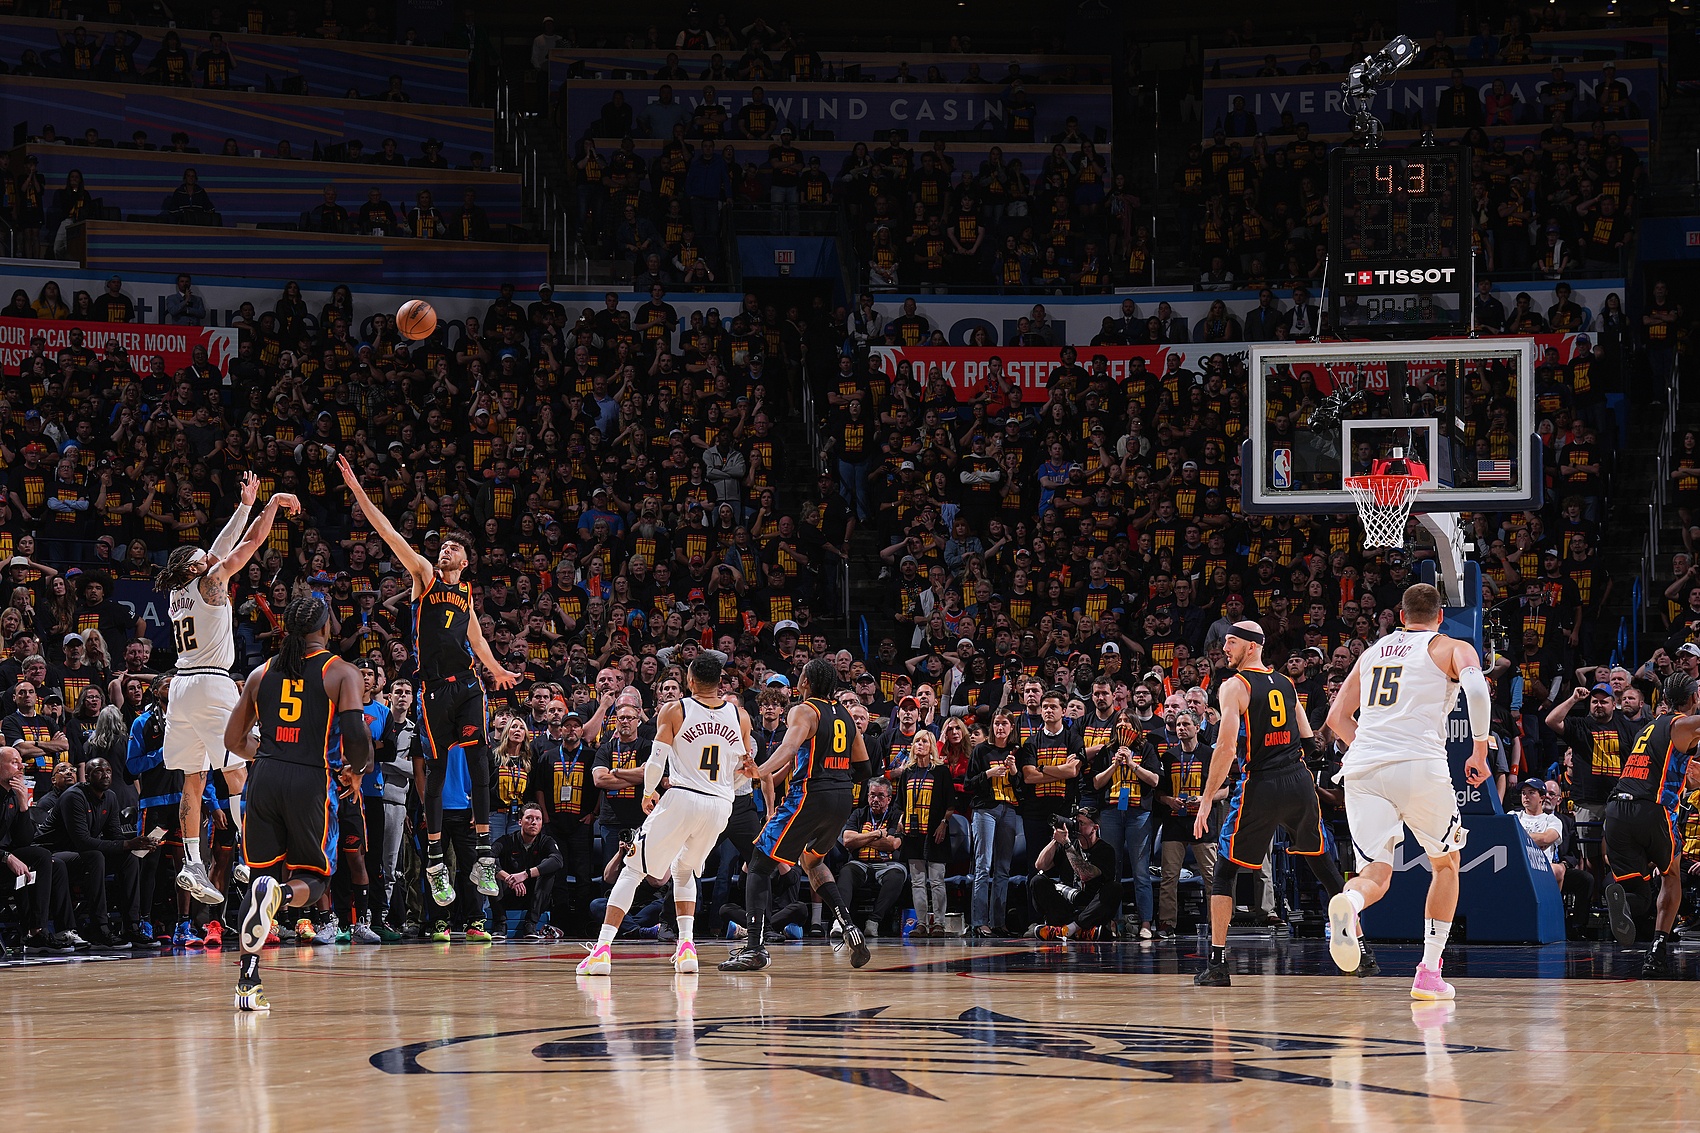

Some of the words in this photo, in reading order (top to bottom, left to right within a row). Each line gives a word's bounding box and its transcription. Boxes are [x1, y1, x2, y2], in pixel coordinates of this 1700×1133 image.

[889, 99, 1003, 121] CASIN
[1375, 163, 1425, 194] 4.3
[777, 251, 793, 263] EXIT
[1374, 268, 1456, 284] TISSOT
[144, 333, 186, 353] MOON
[428, 591, 468, 613] OKLAHOMA
[444, 609, 455, 629] 7
[1367, 664, 1404, 709] 15
[279, 678, 305, 723] 5
[1268, 689, 1287, 728] 9
[275, 726, 301, 743] DORT
[681, 722, 740, 747] WESTBROOK
[833, 719, 847, 753] 8
[1264, 731, 1291, 747] CARUSO
[1632, 723, 1655, 754] 2
[698, 743, 720, 783] 4
[1454, 785, 1481, 807] gle
